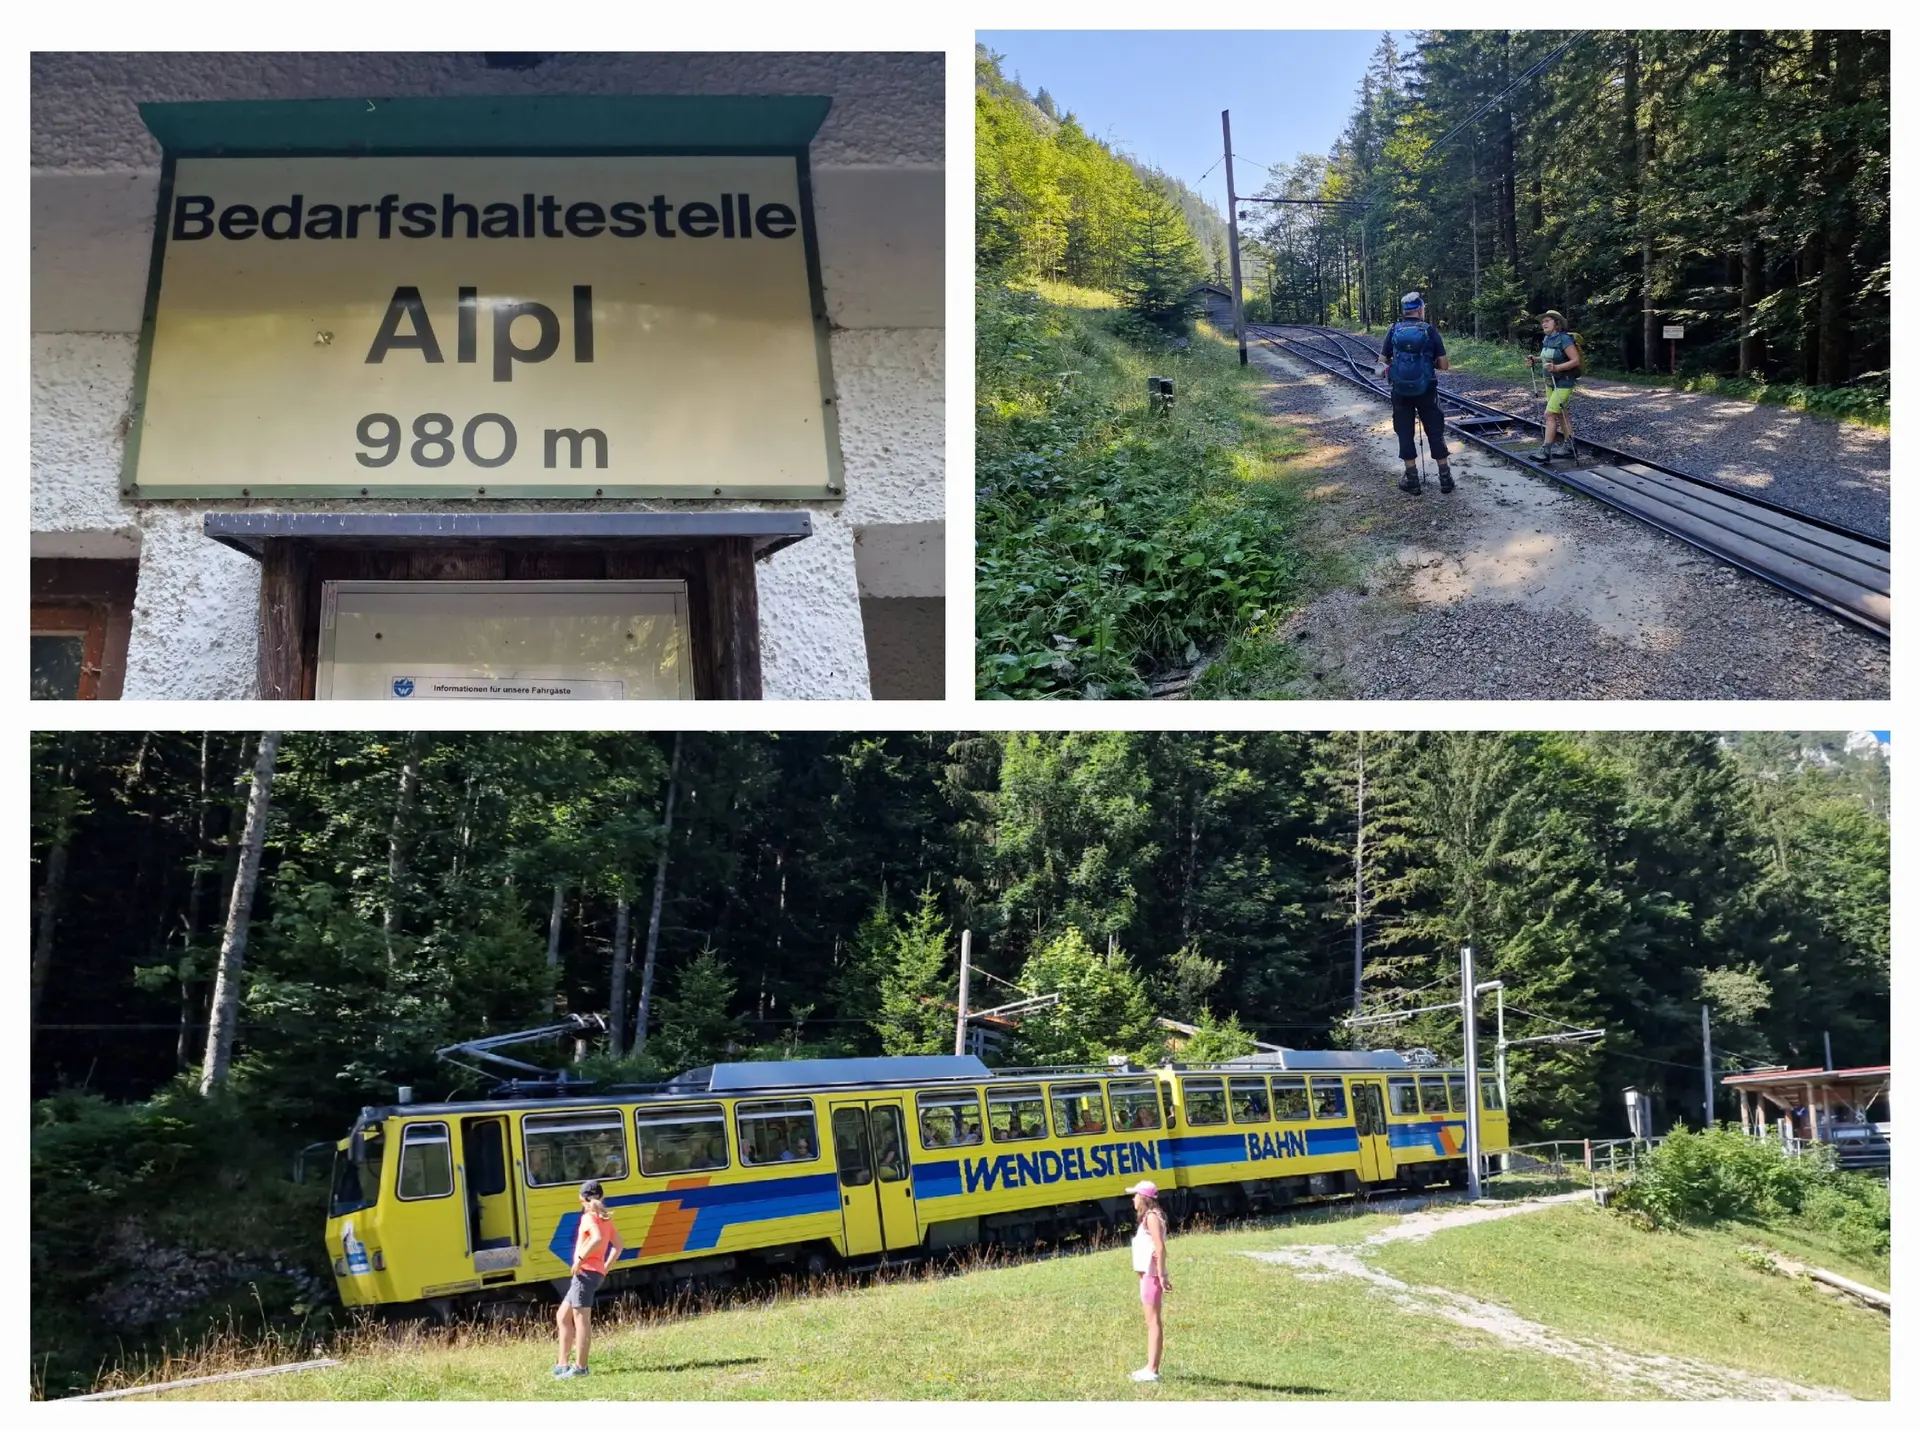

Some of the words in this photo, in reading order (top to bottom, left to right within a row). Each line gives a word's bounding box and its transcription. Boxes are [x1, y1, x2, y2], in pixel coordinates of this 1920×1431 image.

[171, 192, 797, 242] Bedarfshaltestelle
[364, 285, 595, 383] Aipl
[354, 412, 518, 469] 980
[543, 424, 609, 469] m
[433, 684, 488, 692] Informationen
[490, 685, 501, 693] für
[503, 686, 530, 694] unsere
[531, 686, 571, 696] Fahrgäste
[963, 1139, 1158, 1194] WENDELSTEIN
[1247, 1129, 1306, 1161] BAHN
